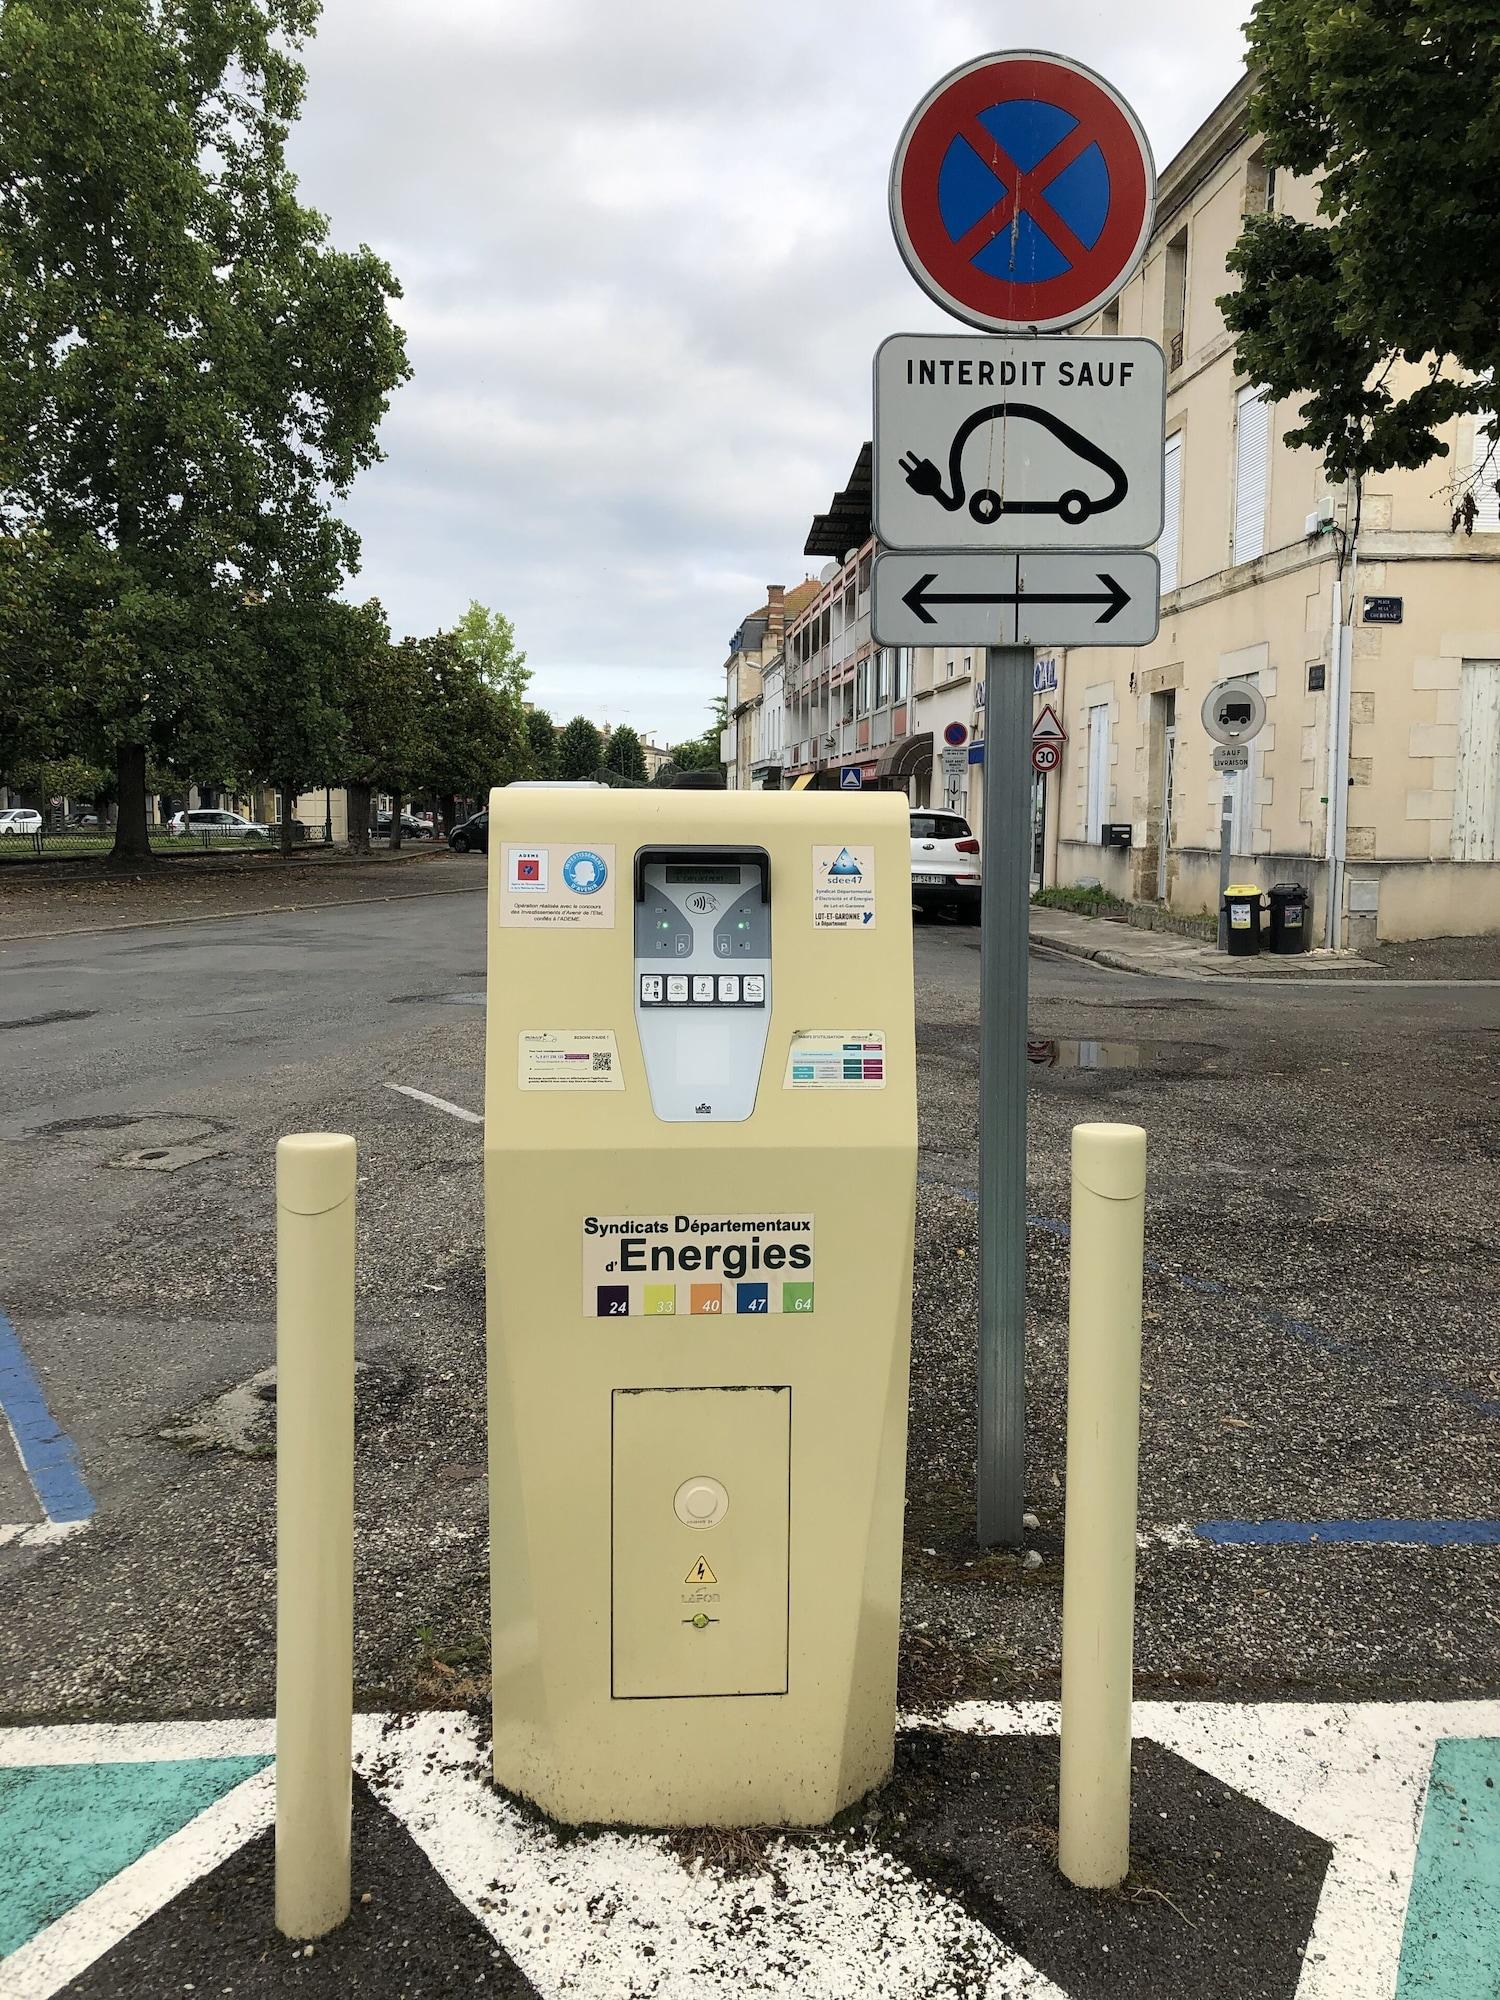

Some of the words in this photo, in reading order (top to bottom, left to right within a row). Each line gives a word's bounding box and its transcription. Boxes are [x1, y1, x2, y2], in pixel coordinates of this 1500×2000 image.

[907, 359, 1046, 386] INTERDIT
[1058, 361, 1134, 387] SAUF
[1038, 751, 1054, 763] 30
[571, 884, 598, 892] D'AVENIR
[584, 1217, 669, 1237] Syndicats
[674, 1216, 810, 1235] Départementaux
[609, 1301, 626, 1314] 24
[656, 1301, 673, 1313] 33
[702, 1300, 720, 1312] 40
[748, 1299, 766, 1311] 47
[795, 1299, 812, 1310] 64
